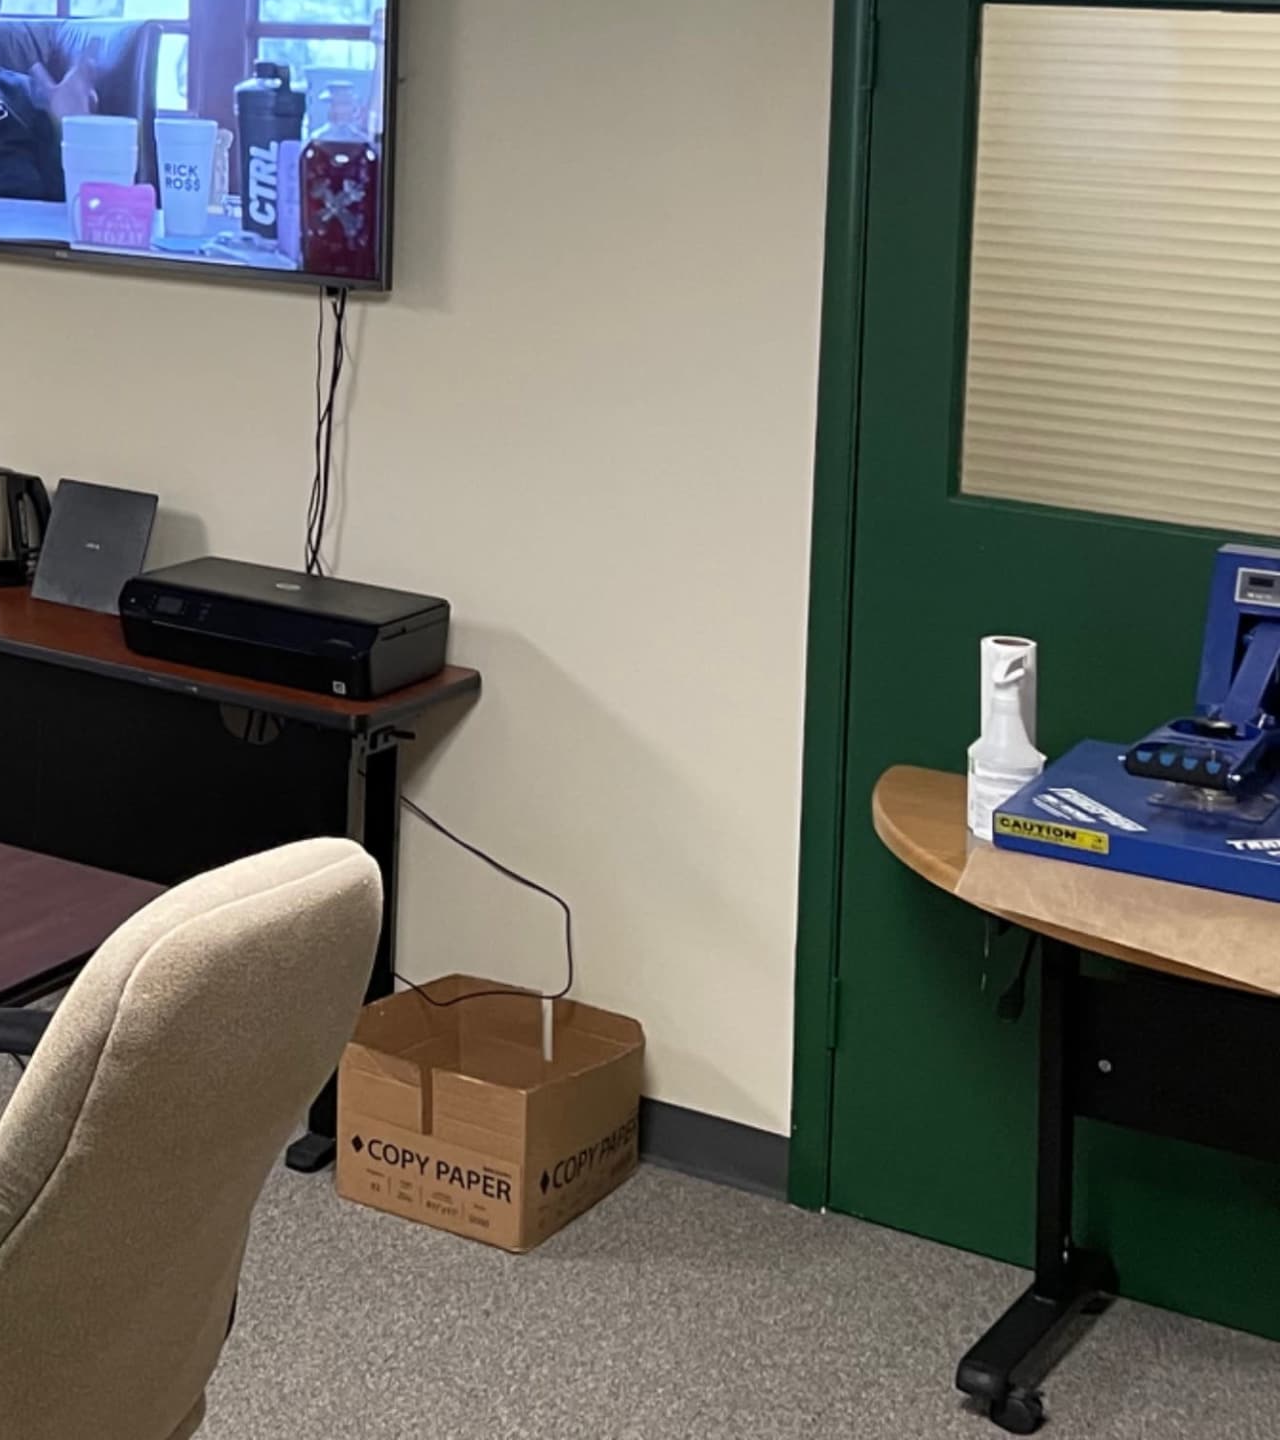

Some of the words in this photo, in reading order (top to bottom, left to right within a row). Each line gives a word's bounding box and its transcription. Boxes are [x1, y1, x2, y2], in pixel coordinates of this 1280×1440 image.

[164, 162, 199, 177] RICK
[248, 139, 279, 226] CTRL
[999, 816, 1077, 841] CAUTION
[367, 1138, 430, 1177] COPY
[435, 1160, 512, 1203] PAPER
[552, 1141, 600, 1189] COPY
